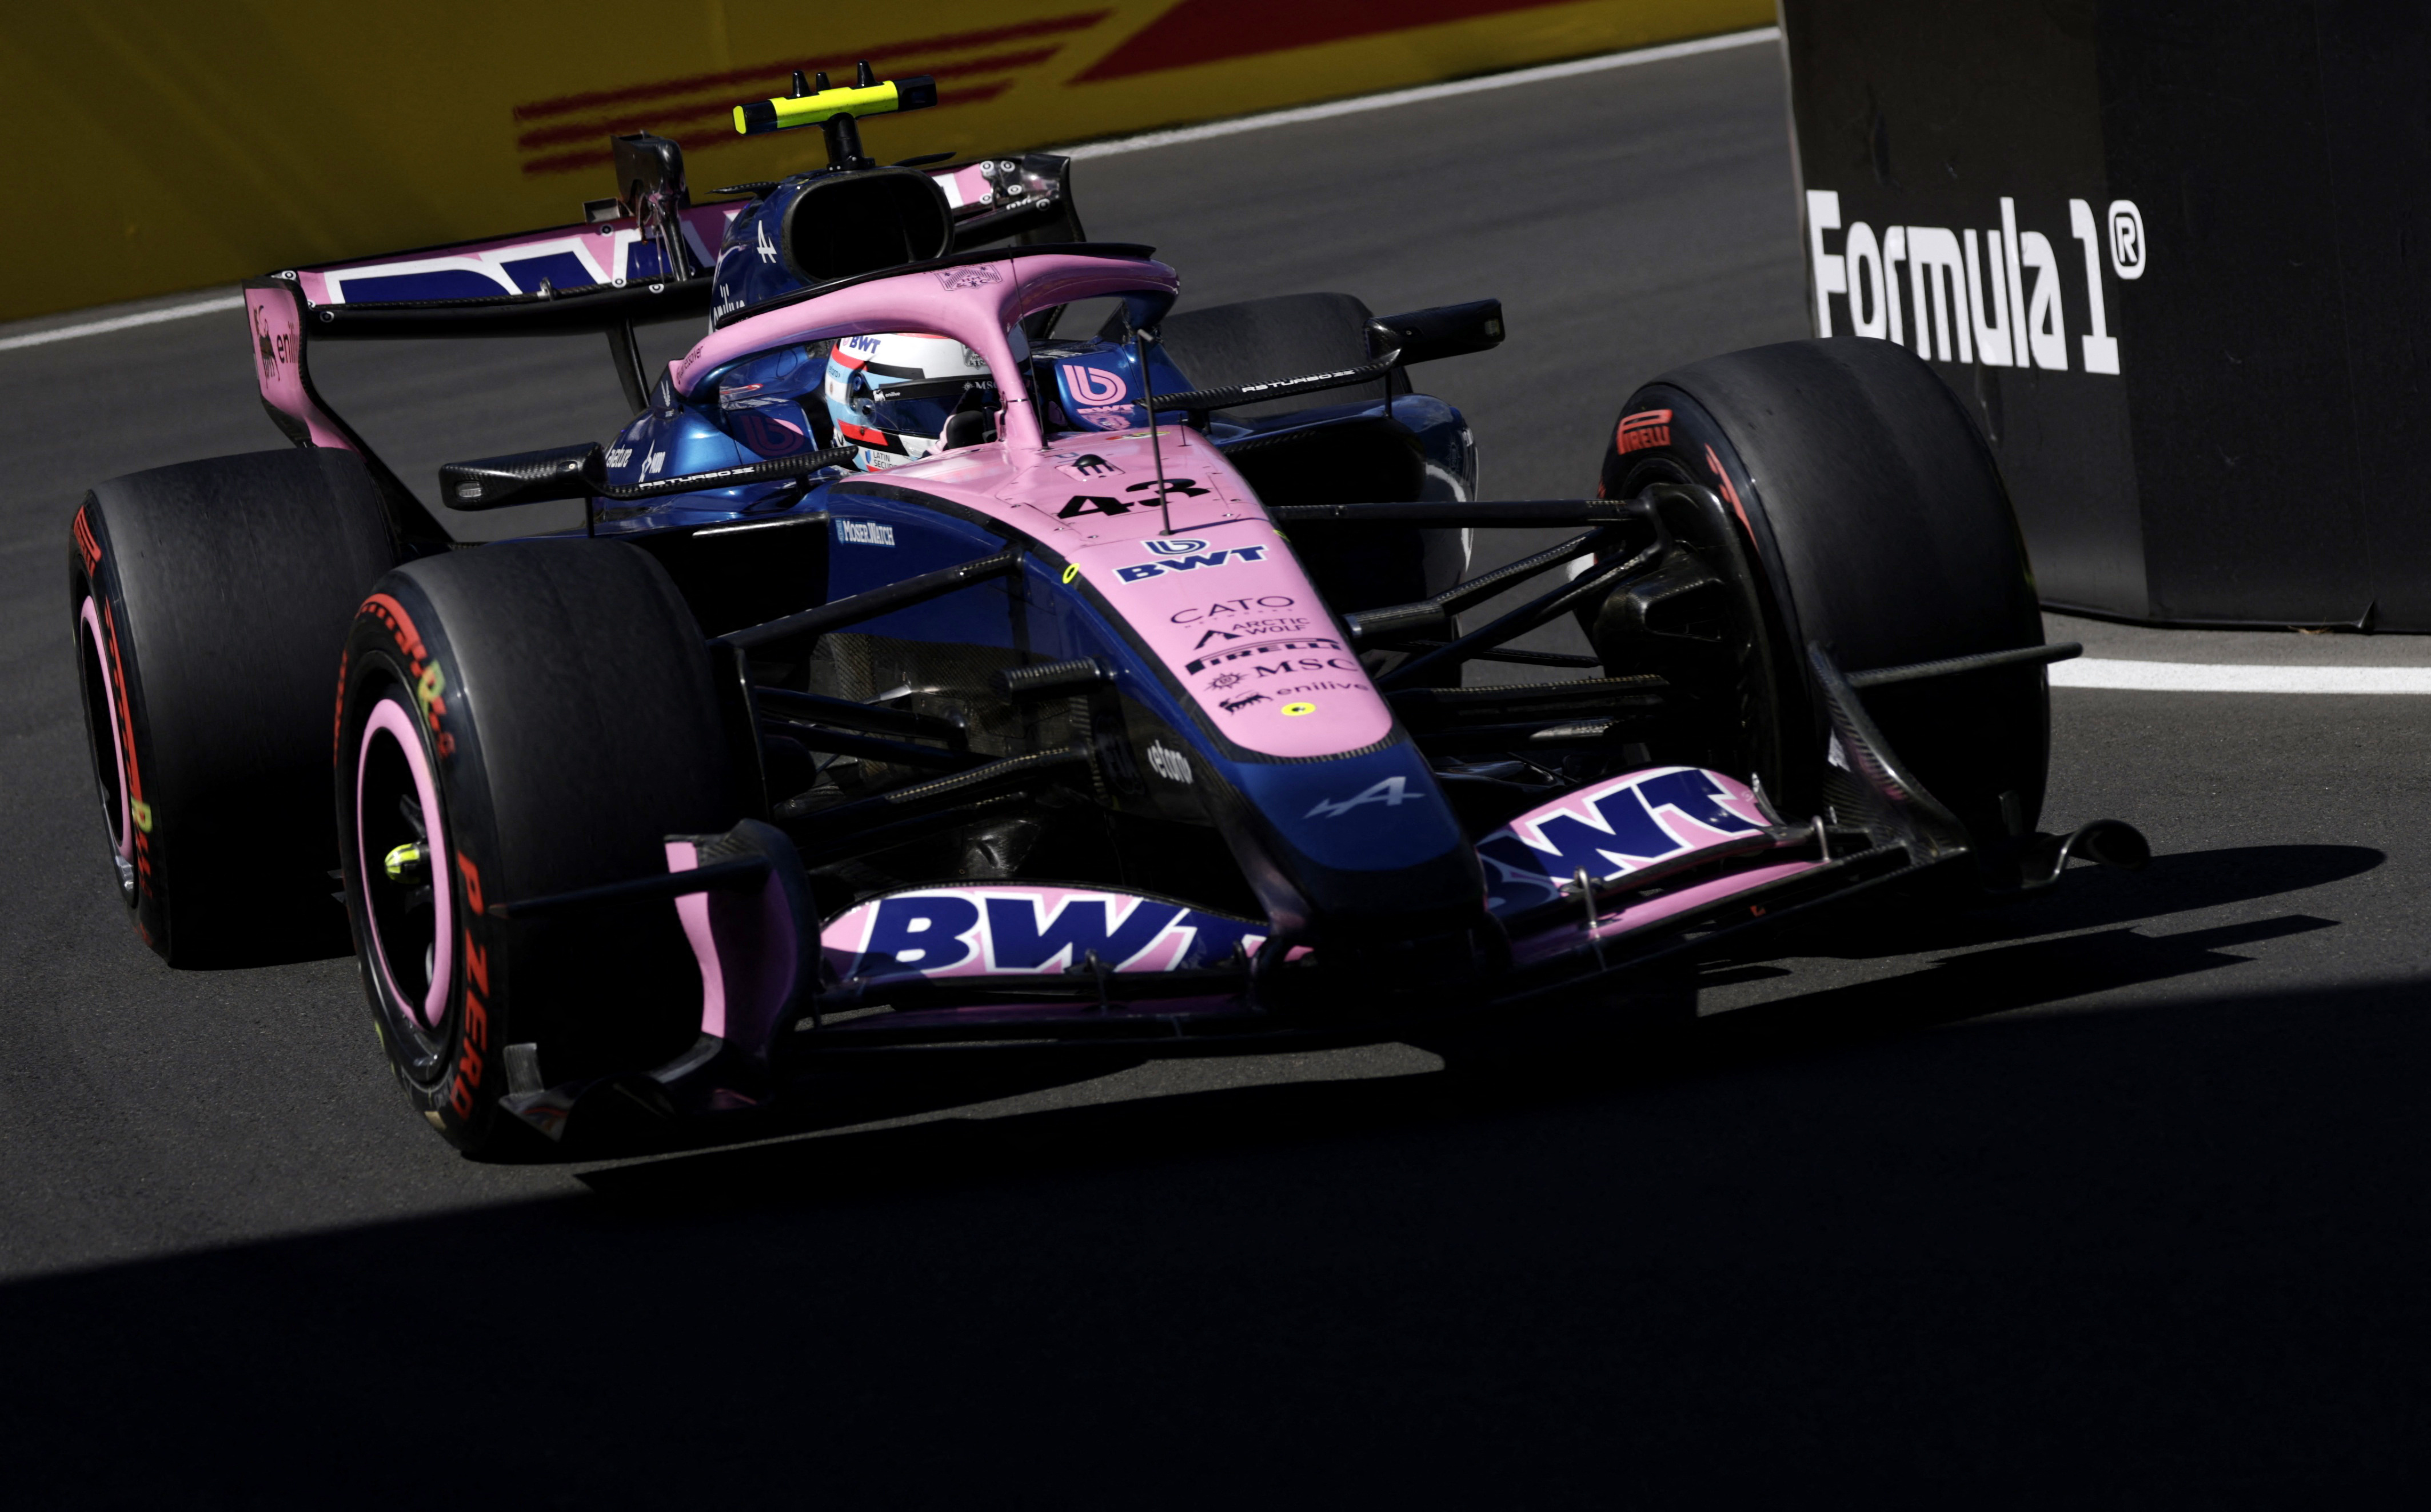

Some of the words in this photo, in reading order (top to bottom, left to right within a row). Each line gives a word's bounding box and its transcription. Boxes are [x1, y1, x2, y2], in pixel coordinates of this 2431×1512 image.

[1806, 190, 2068, 370] Formula
[849, 335, 881, 354] BWT
[1617, 409, 1674, 456] PIRELLI
[873, 451, 890, 462] LATIN
[1057, 478, 1211, 519] 43
[1115, 546, 1266, 583] BWT
[1170, 596, 1295, 623] CATO
[1232, 618, 1310, 630] ARCTIC
[1245, 625, 1306, 634] WOLF
[1185, 638, 1342, 675] PIRELLI
[1252, 658, 1359, 678] MSC
[1276, 681, 1370, 695] enilive
[851, 895, 1270, 973] BWT
[450, 927, 490, 1121] ZERO
